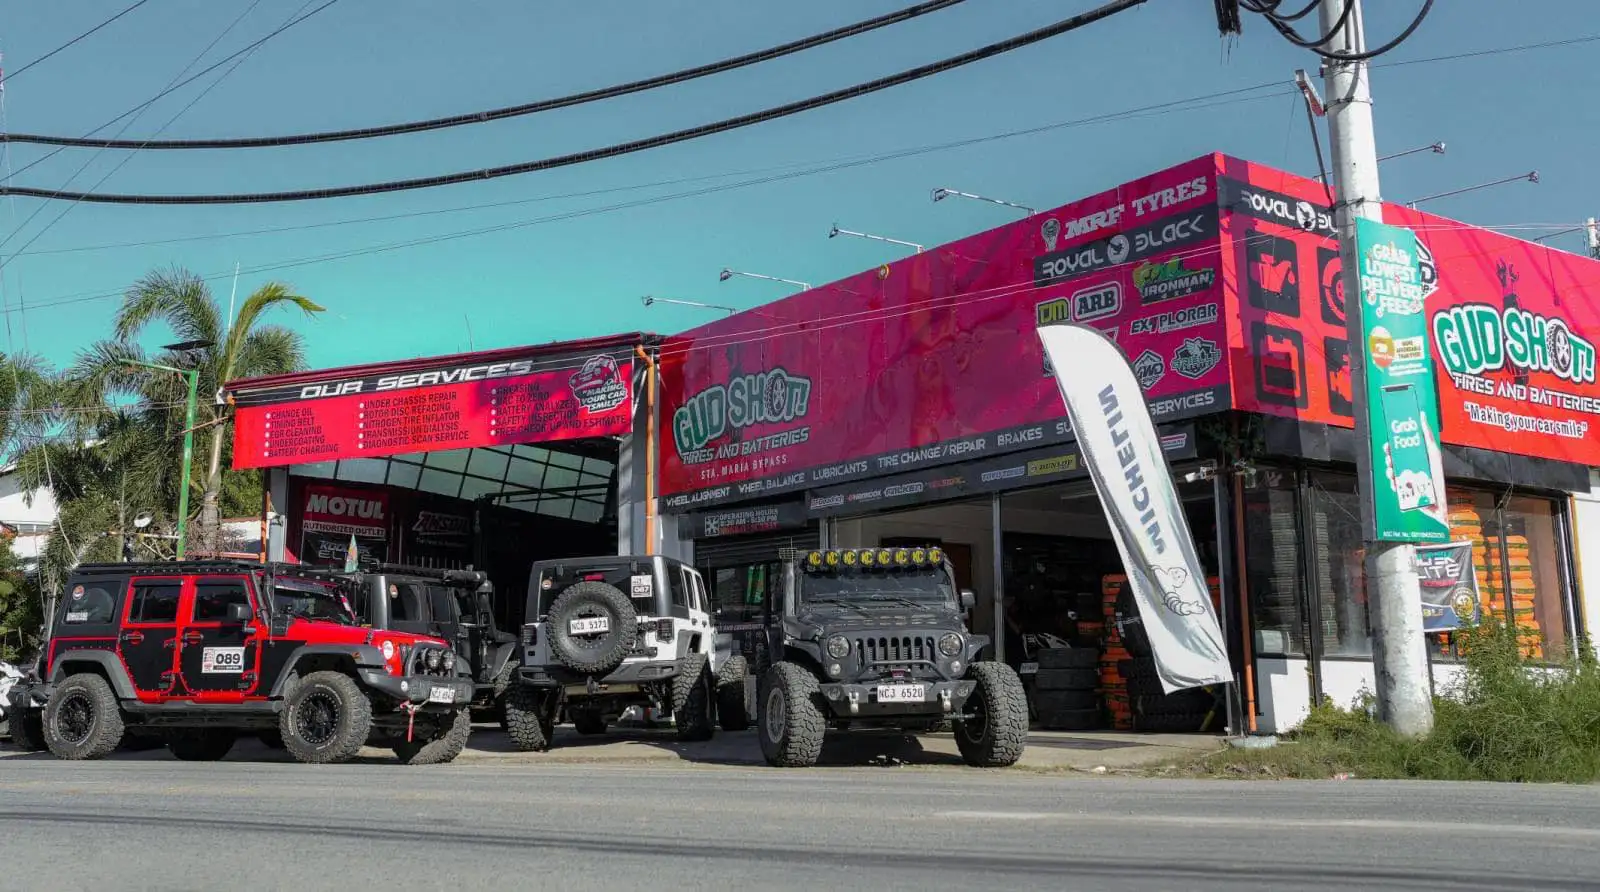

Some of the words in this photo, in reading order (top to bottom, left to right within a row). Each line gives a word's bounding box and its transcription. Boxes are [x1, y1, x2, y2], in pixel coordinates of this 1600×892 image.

[1064, 204, 1125, 240] MRF
[1132, 176, 1207, 217] TYRES
[1042, 249, 1104, 278] ROYAL
[1135, 215, 1204, 252] BLACK
[1366, 258, 1417, 283] LOWEST
[1144, 272, 1210, 297] IRONMAN
[1078, 291, 1116, 315] ARB
[1434, 303, 1505, 375] GUD
[1504, 307, 1596, 383] SHOT!
[300, 381, 363, 399] OUR
[376, 360, 533, 391] SERVICES
[364, 400, 391, 409] UNDER
[393, 395, 426, 406] CHASSIS
[429, 392, 457, 401] REPAIR
[582, 395, 606, 405] YOUR
[608, 391, 626, 399] CAR
[1452, 373, 1495, 395] TIRES
[1497, 381, 1527, 400] AND
[1530, 388, 1600, 413] BATTERIES
[271, 410, 300, 420] CHANGE
[302, 408, 313, 416] OIL
[392, 406, 409, 416] DISC
[411, 402, 451, 414] REFACING
[497, 404, 530, 416] BATTERY
[673, 385, 727, 452] GUD
[728, 367, 811, 428] SHOT!
[297, 417, 315, 426] BELT
[364, 417, 401, 429] NITROGEN
[404, 415, 421, 424] TIRE
[422, 412, 460, 423] INFLATOR
[1392, 417, 1418, 434] Grab
[1512, 416, 1536, 432] your
[1538, 419, 1554, 432] car
[286, 427, 322, 437] CLEANING
[363, 437, 409, 449] DIAGNOSTIC
[412, 434, 433, 444] SCAN
[436, 431, 469, 442] SERVICE
[364, 425, 421, 439] TRANSMISSION
[270, 436, 325, 448] UNDERCOATING
[667, 496, 690, 507] WHEEL
[691, 487, 731, 503] ALIGNMENT
[738, 480, 765, 493] WHEEL
[767, 473, 805, 489] BALANCE
[813, 461, 868, 481] LUBRICANTS
[878, 454, 899, 469] TIRE
[998, 427, 1044, 446] BRAKES
[1150, 392, 1215, 416] SERVICES
[681, 448, 715, 465] TIRES
[715, 443, 740, 459] AND
[741, 427, 810, 456] BATTERIES
[1394, 433, 1421, 449] Food
[269, 447, 298, 458] BATTERY
[301, 444, 339, 455] CHARGING
[701, 469, 720, 481] STA.
[722, 463, 750, 477] MARIA
[752, 454, 788, 470] BYPASS
[1098, 384, 1167, 555] MICHELIN
[306, 494, 385, 520] MOTUL
[720, 512, 754, 521] OPERATING
[304, 521, 354, 535] AUTHORIZED
[216, 654, 241, 665] 089
[901, 688, 923, 698] 6520
